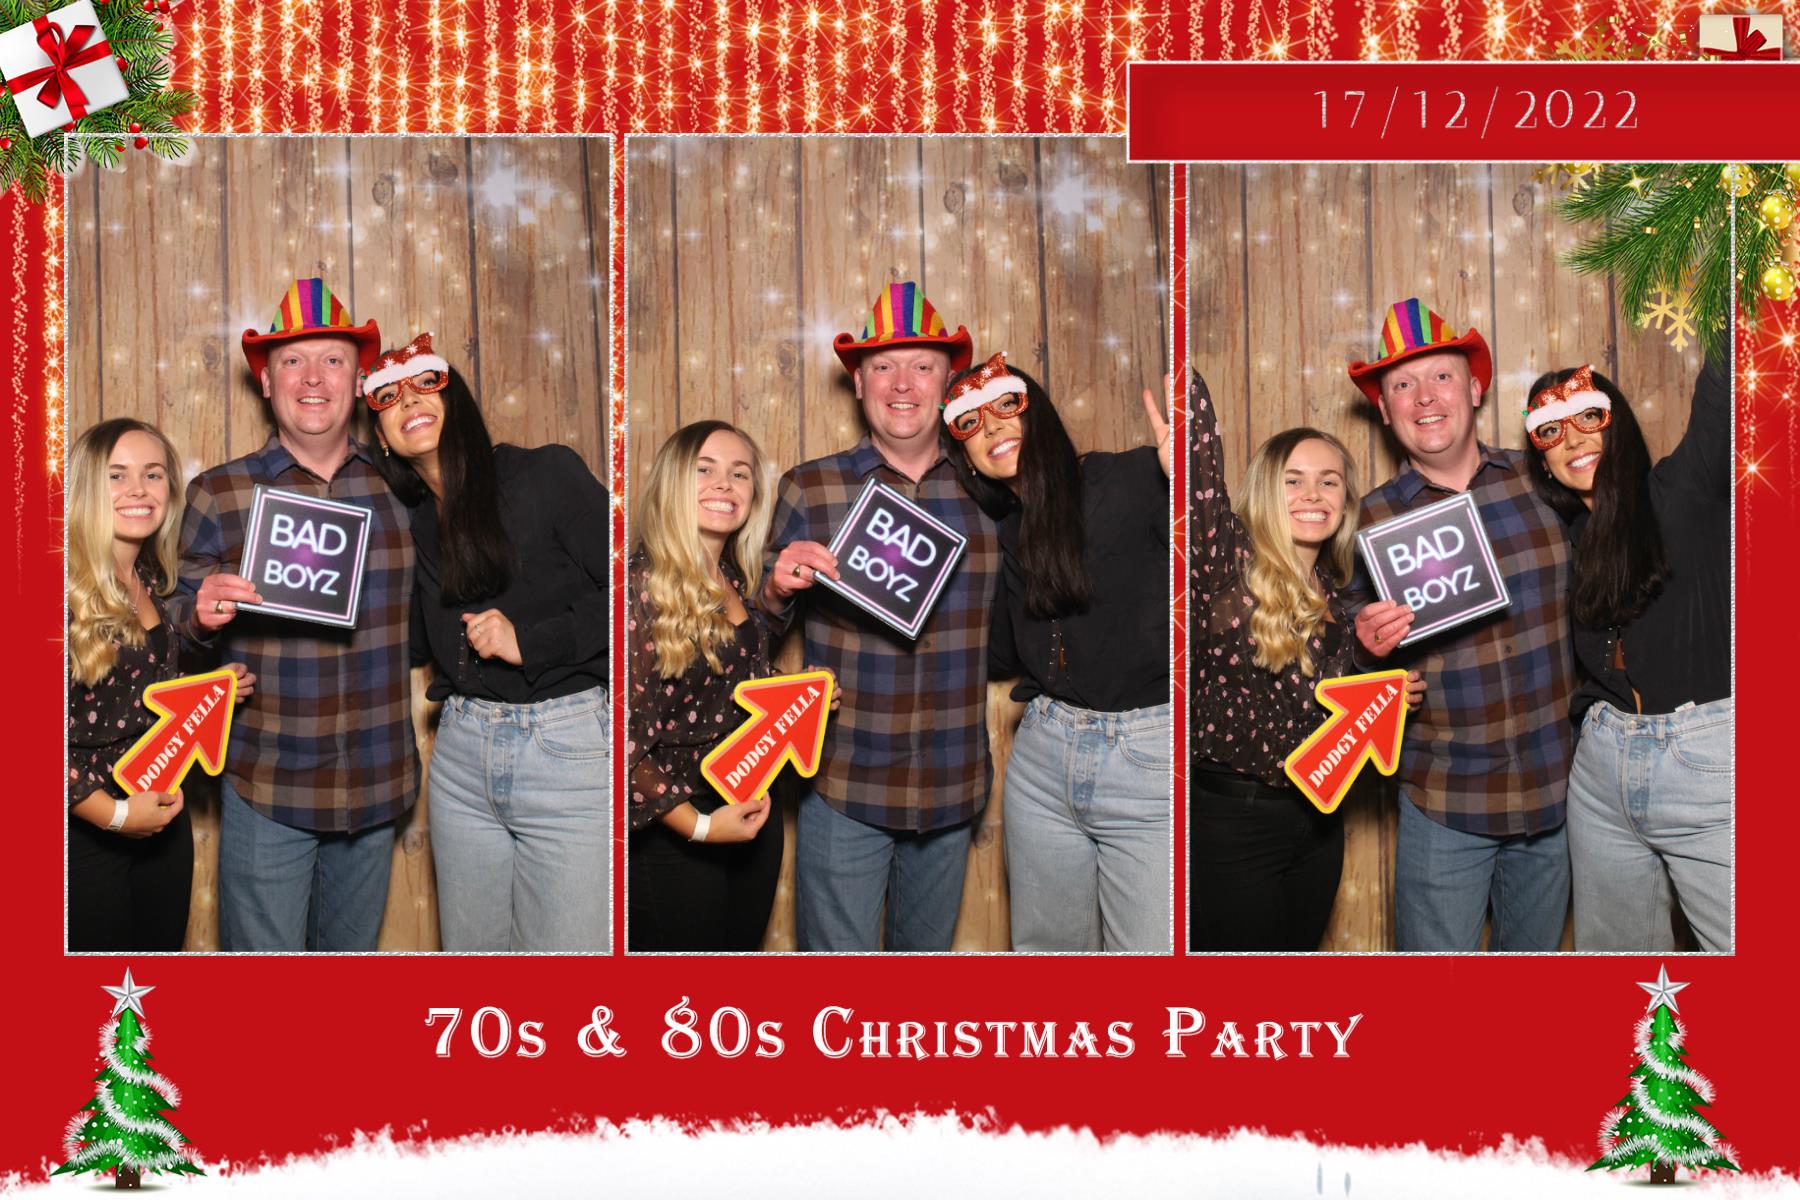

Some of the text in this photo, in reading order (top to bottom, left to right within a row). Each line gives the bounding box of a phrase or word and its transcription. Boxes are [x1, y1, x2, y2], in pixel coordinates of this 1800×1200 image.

[270, 514, 347, 556] BAD
[865, 507, 937, 567] BAD
[1387, 525, 1465, 576] BAD
[264, 559, 341, 596] BOYZ
[847, 545, 919, 602] BOYZ
[1403, 565, 1480, 612] BOYZ
[136, 684, 226, 792] DODGY FELLA
[724, 685, 821, 789] DODGY FELLA
[1308, 683, 1399, 788] DODGY FELLA
